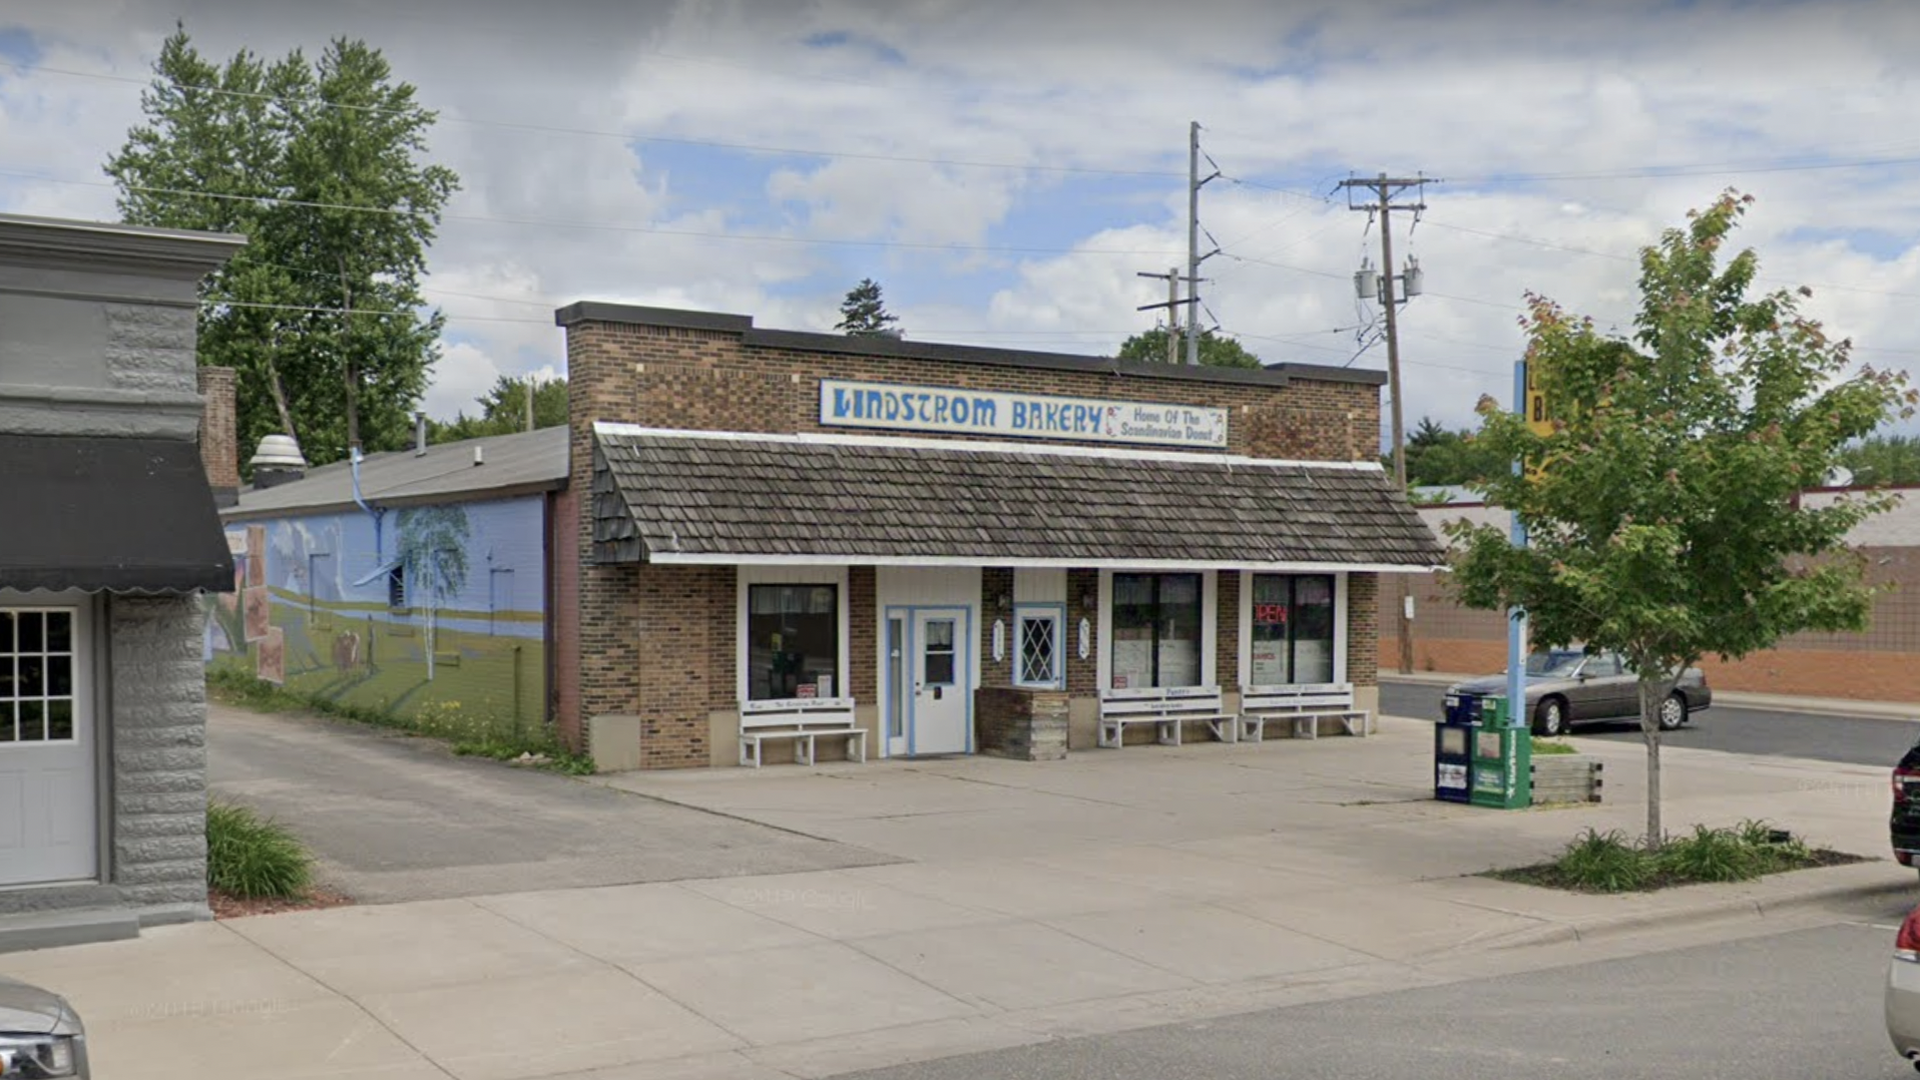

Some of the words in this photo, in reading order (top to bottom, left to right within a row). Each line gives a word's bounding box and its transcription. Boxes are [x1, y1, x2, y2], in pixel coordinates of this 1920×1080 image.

[833, 388, 996, 427] LINDSTROM
[1012, 401, 1103, 433] BAKERY
[1134, 406, 1160, 423] Home
[1165, 409, 1178, 424] Of
[1183, 410, 1200, 426] The
[1121, 421, 1183, 440] Scandinavian
[1186, 426, 1212, 441] Donut
